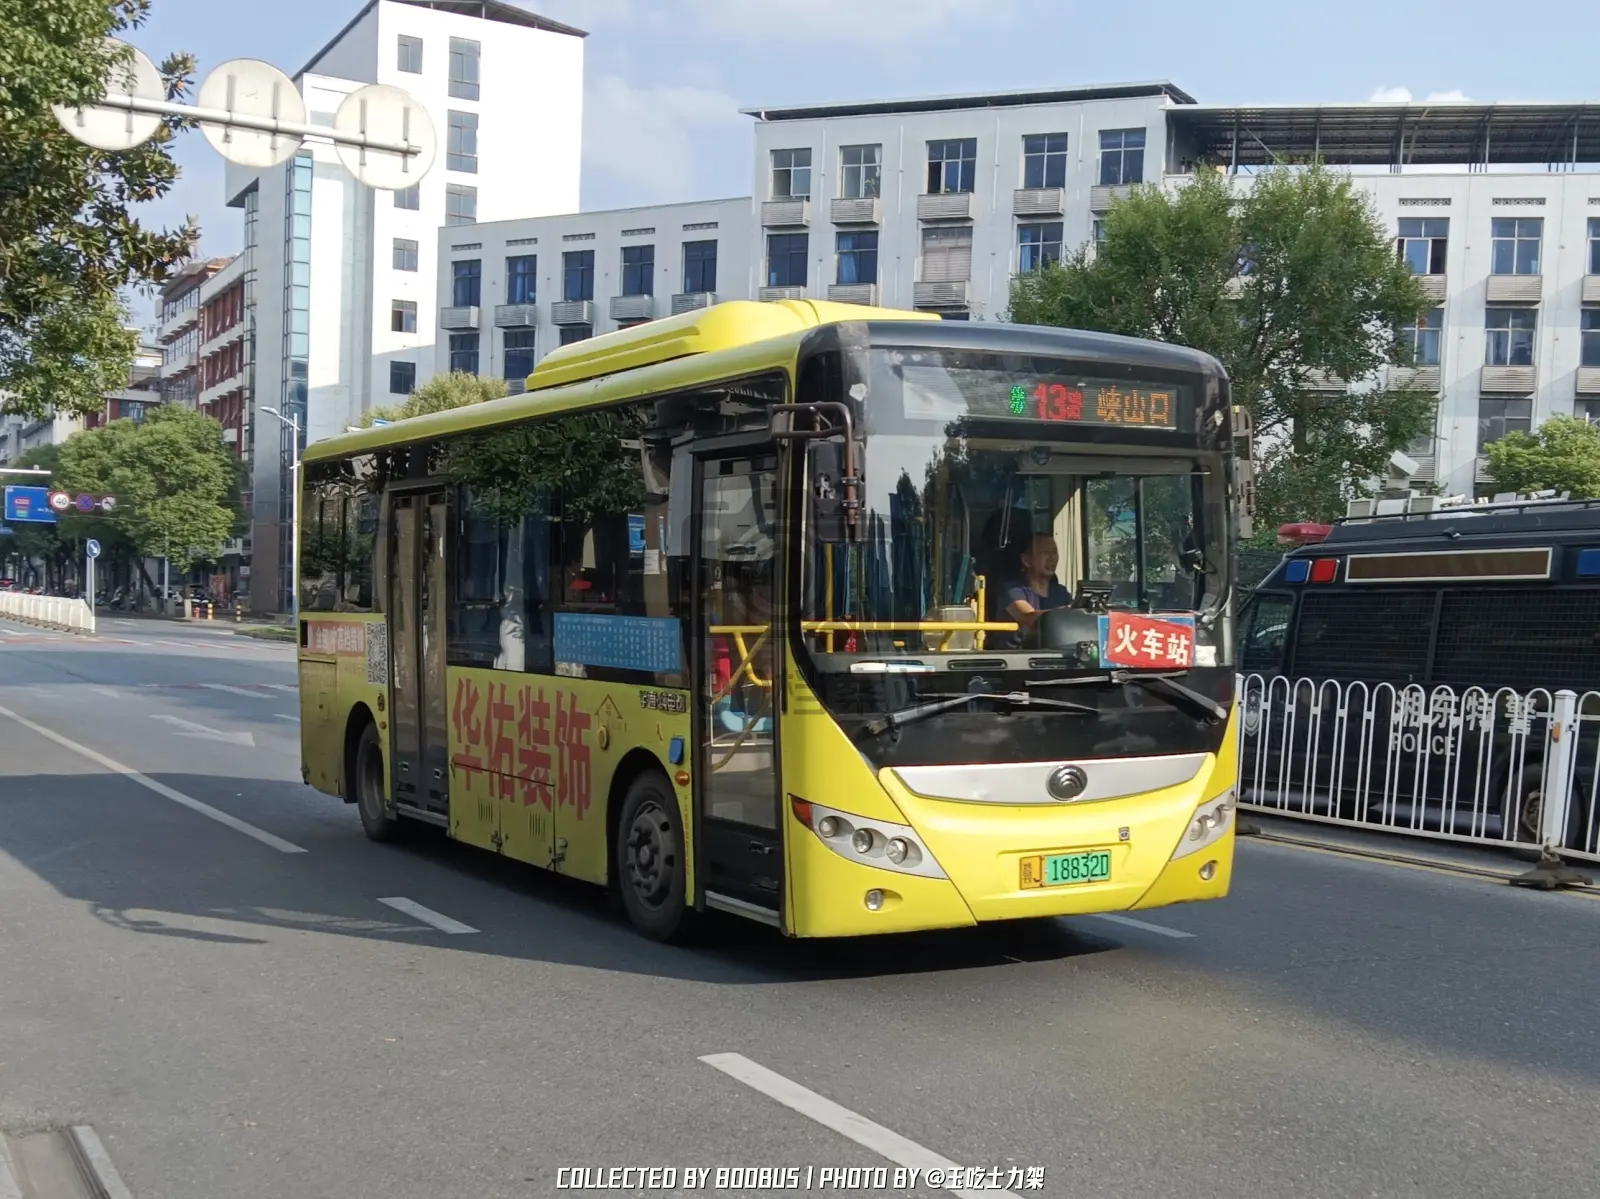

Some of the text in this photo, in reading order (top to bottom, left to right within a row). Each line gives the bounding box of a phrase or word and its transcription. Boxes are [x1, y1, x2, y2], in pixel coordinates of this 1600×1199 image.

[1114, 624, 1190, 665] 火车站
[452, 677, 592, 821] 华佑装饰
